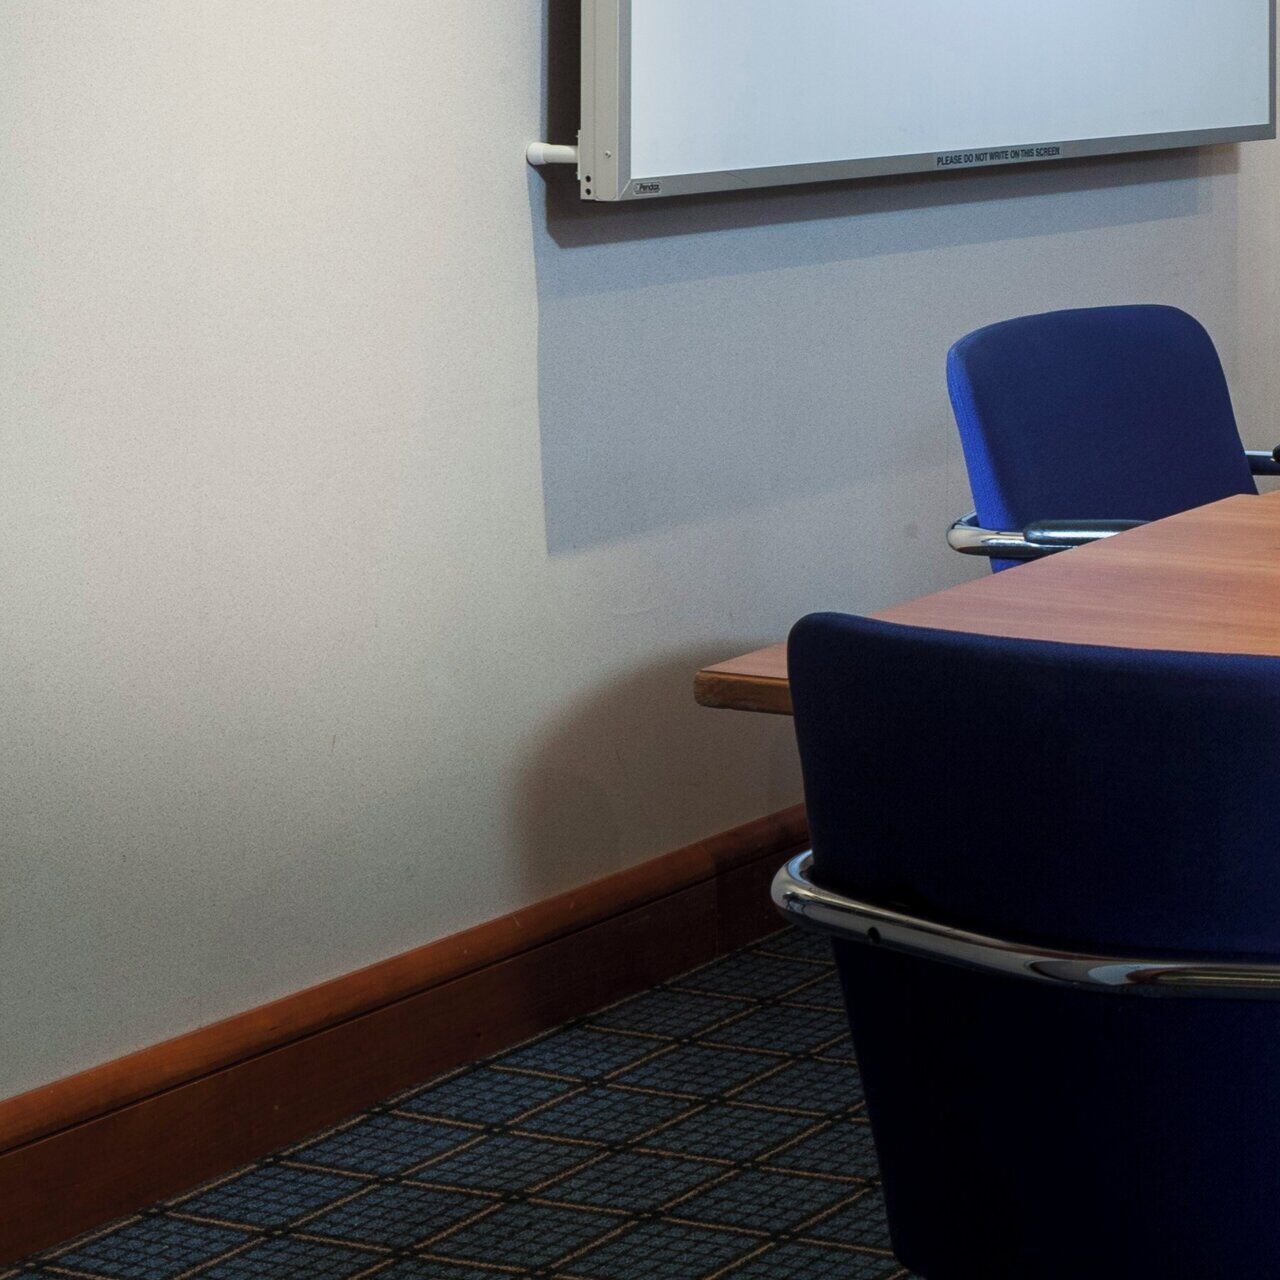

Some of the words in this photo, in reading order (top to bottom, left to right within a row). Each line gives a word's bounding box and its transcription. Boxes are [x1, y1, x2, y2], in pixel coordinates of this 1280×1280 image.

[937, 154, 962, 167] PLEASE
[964, 153, 974, 163] DO
[975, 152, 988, 162] NOT
[989, 150, 1009, 161] WRITE
[1010, 149, 1020, 159] ON
[1020, 148, 1035, 158] THIS
[1035, 146, 1060, 157] SCREEN
